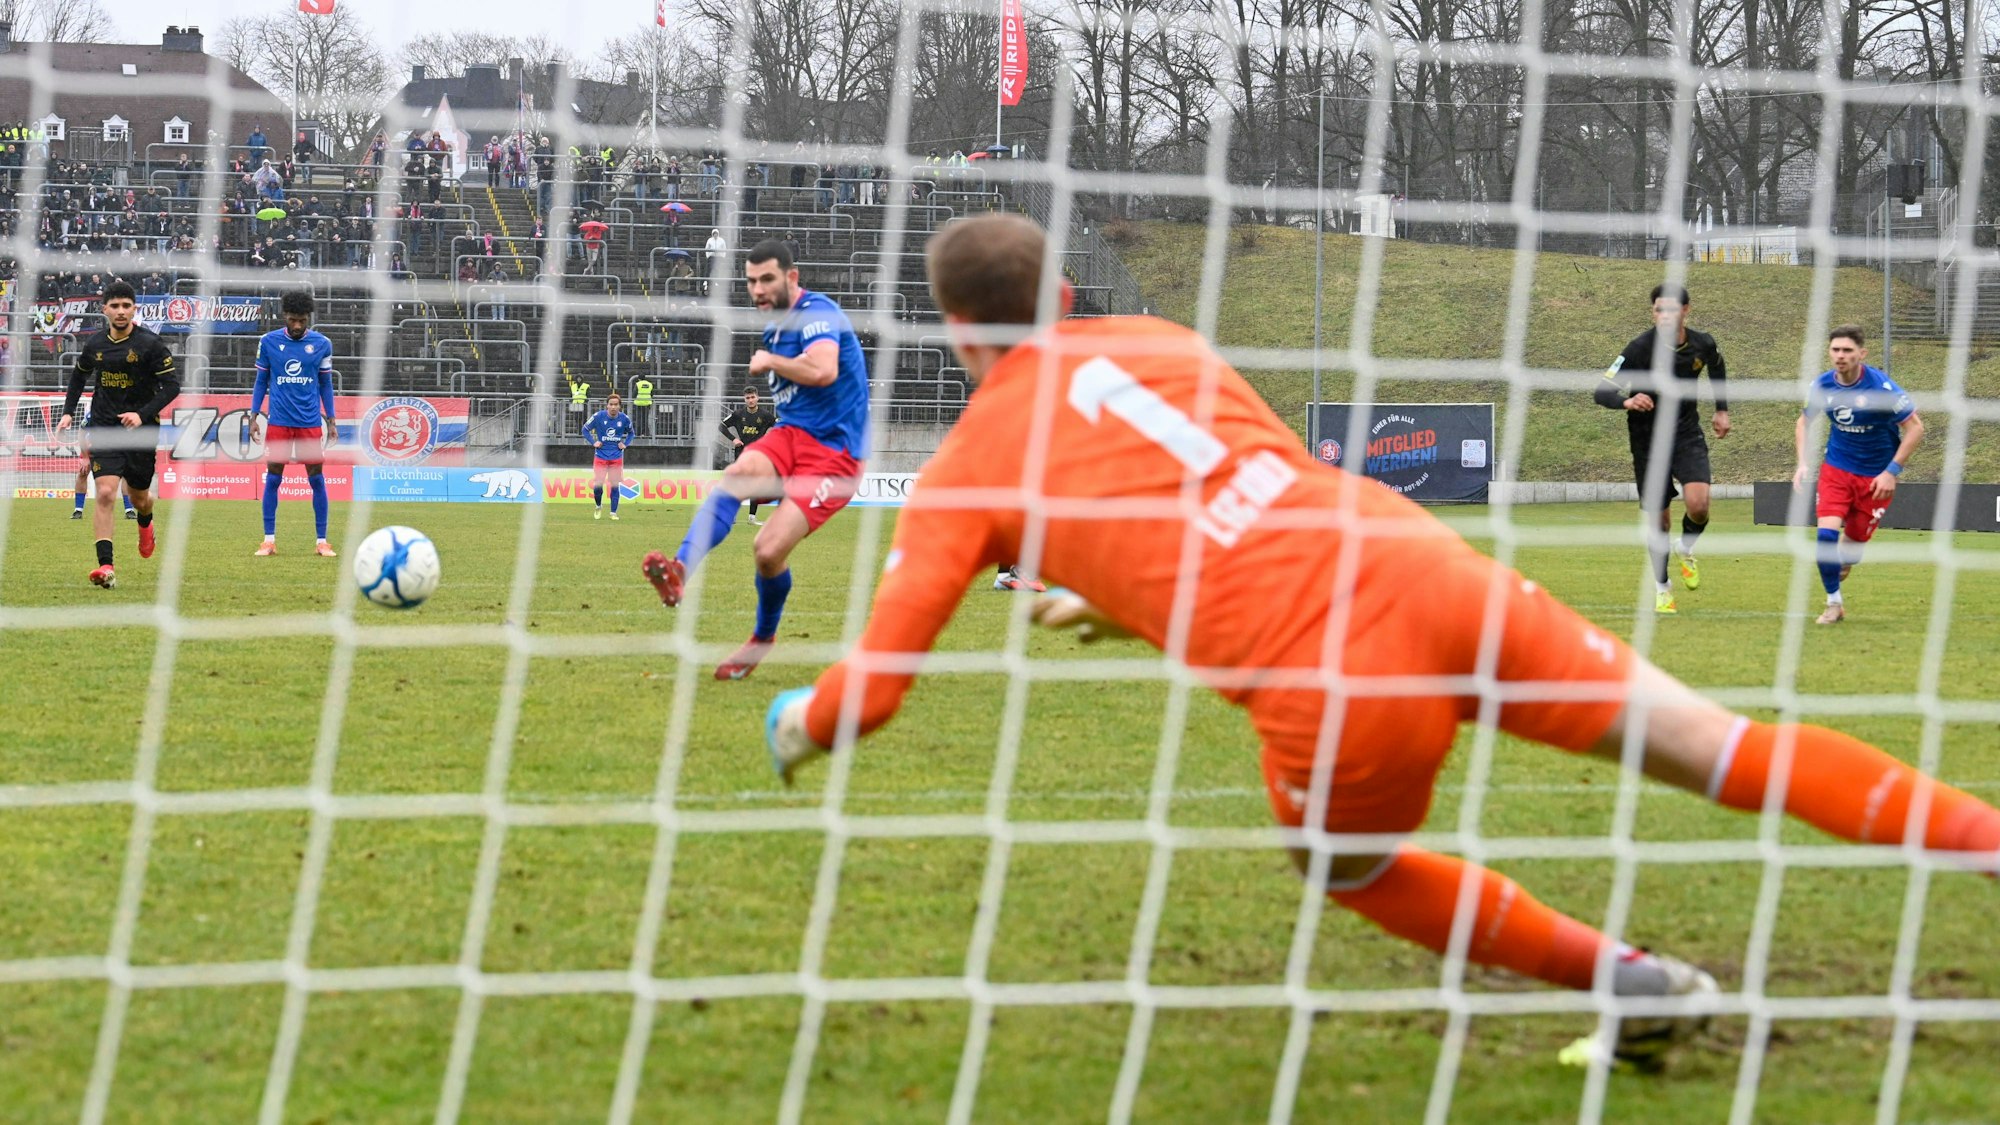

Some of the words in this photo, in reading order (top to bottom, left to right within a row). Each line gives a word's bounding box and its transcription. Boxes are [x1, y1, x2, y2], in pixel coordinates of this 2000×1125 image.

[1005, 0, 1017, 62] RIEDE
[208, 296, 259, 321] Verein
[101, 371, 128, 380] Rhein
[276, 376, 314, 386] greeny+
[366, 397, 436, 421] WUPPERTALER
[1067, 356, 1229, 477] 1
[1372, 418, 1388, 435] EINER
[1387, 413, 1400, 424] FÜR
[1401, 415, 1415, 425] ALLE
[1366, 429, 1436, 458] MITGLIED
[1366, 445, 1437, 475] WERDEN!
[181, 474, 250, 485] Stadtsparkasse
[281, 475, 347, 485] Stadtsasse
[370, 467, 444, 481] Lückenhaus
[389, 486, 425, 495] Cramer
[857, 478, 914, 497] UTSC
[1404, 472, 1429, 493] ROT-BLAU
[18, 490, 47, 498] WEST
[56, 490, 80, 498] LOT
[181, 486, 229, 496] Wuppertal
[279, 487, 313, 496] Wuppe
